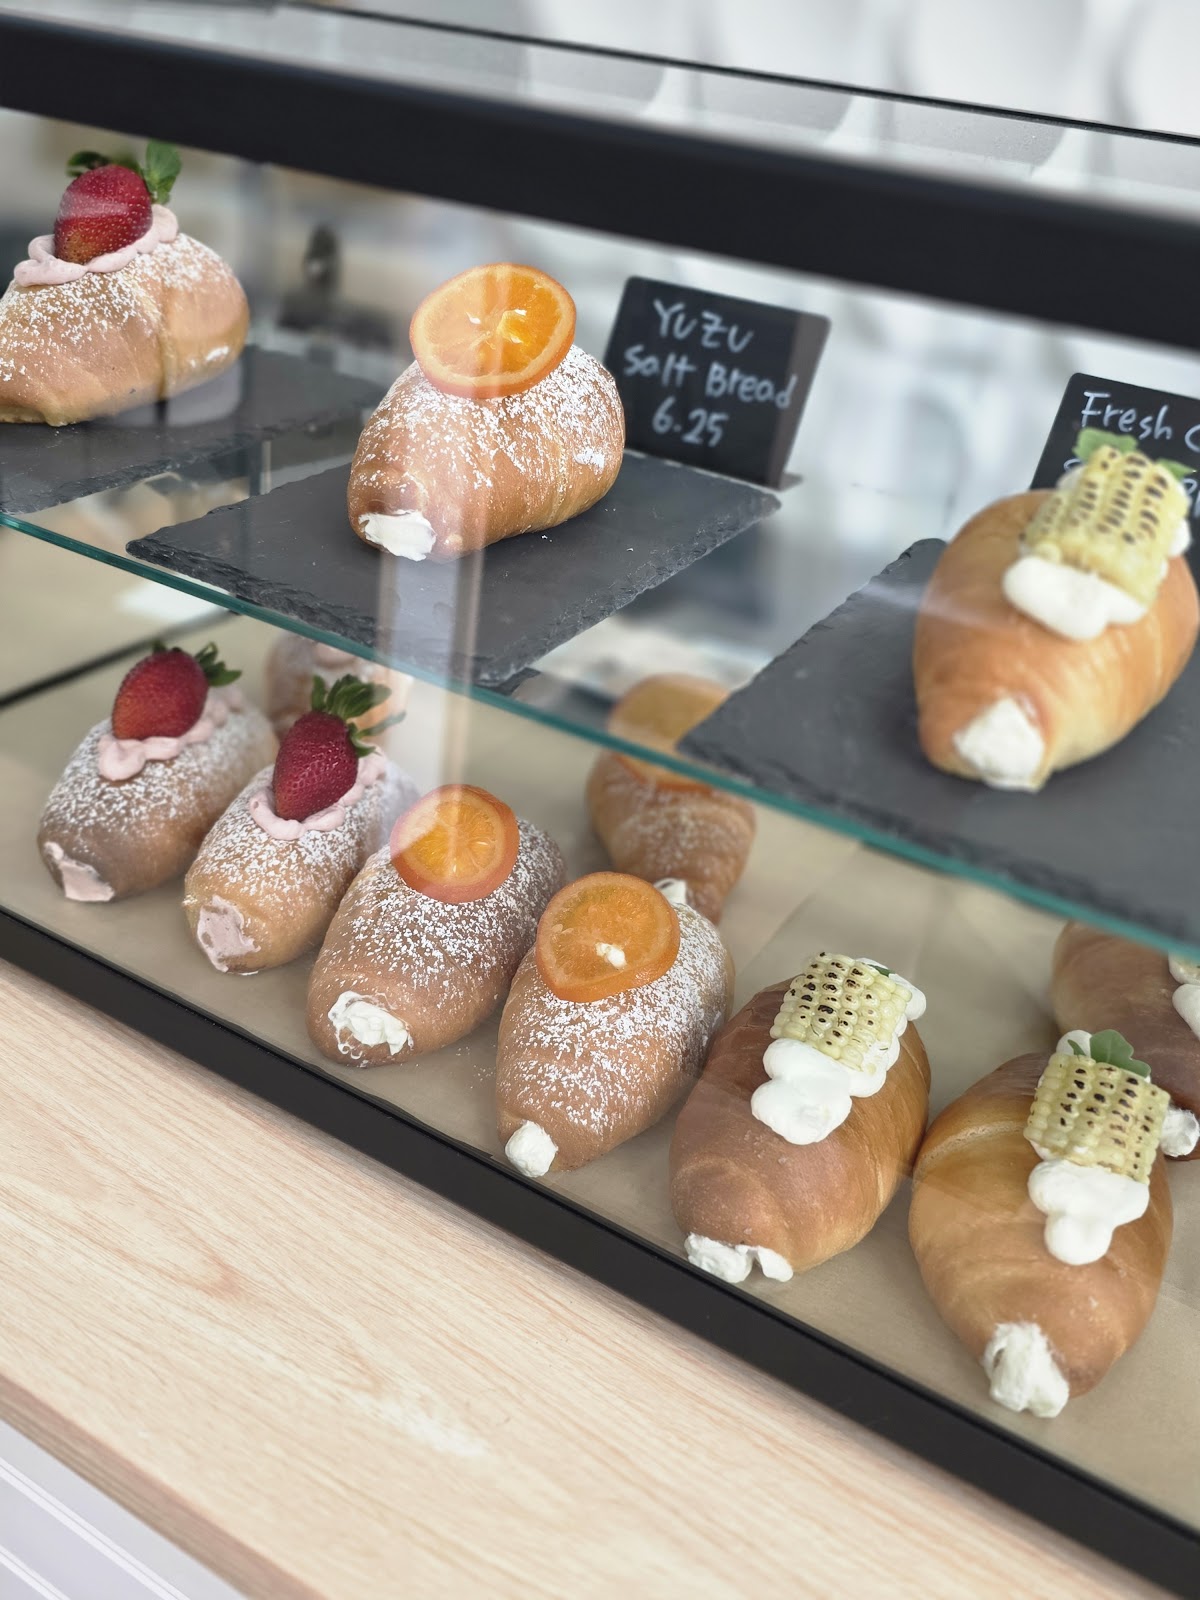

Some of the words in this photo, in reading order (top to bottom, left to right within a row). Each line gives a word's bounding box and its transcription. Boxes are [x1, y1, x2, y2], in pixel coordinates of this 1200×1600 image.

[624, 345, 695, 387] Salt
[706, 361, 797, 408] Bread
[652, 397, 727, 446] 6.25
[1081, 392, 1172, 440] Fresh
